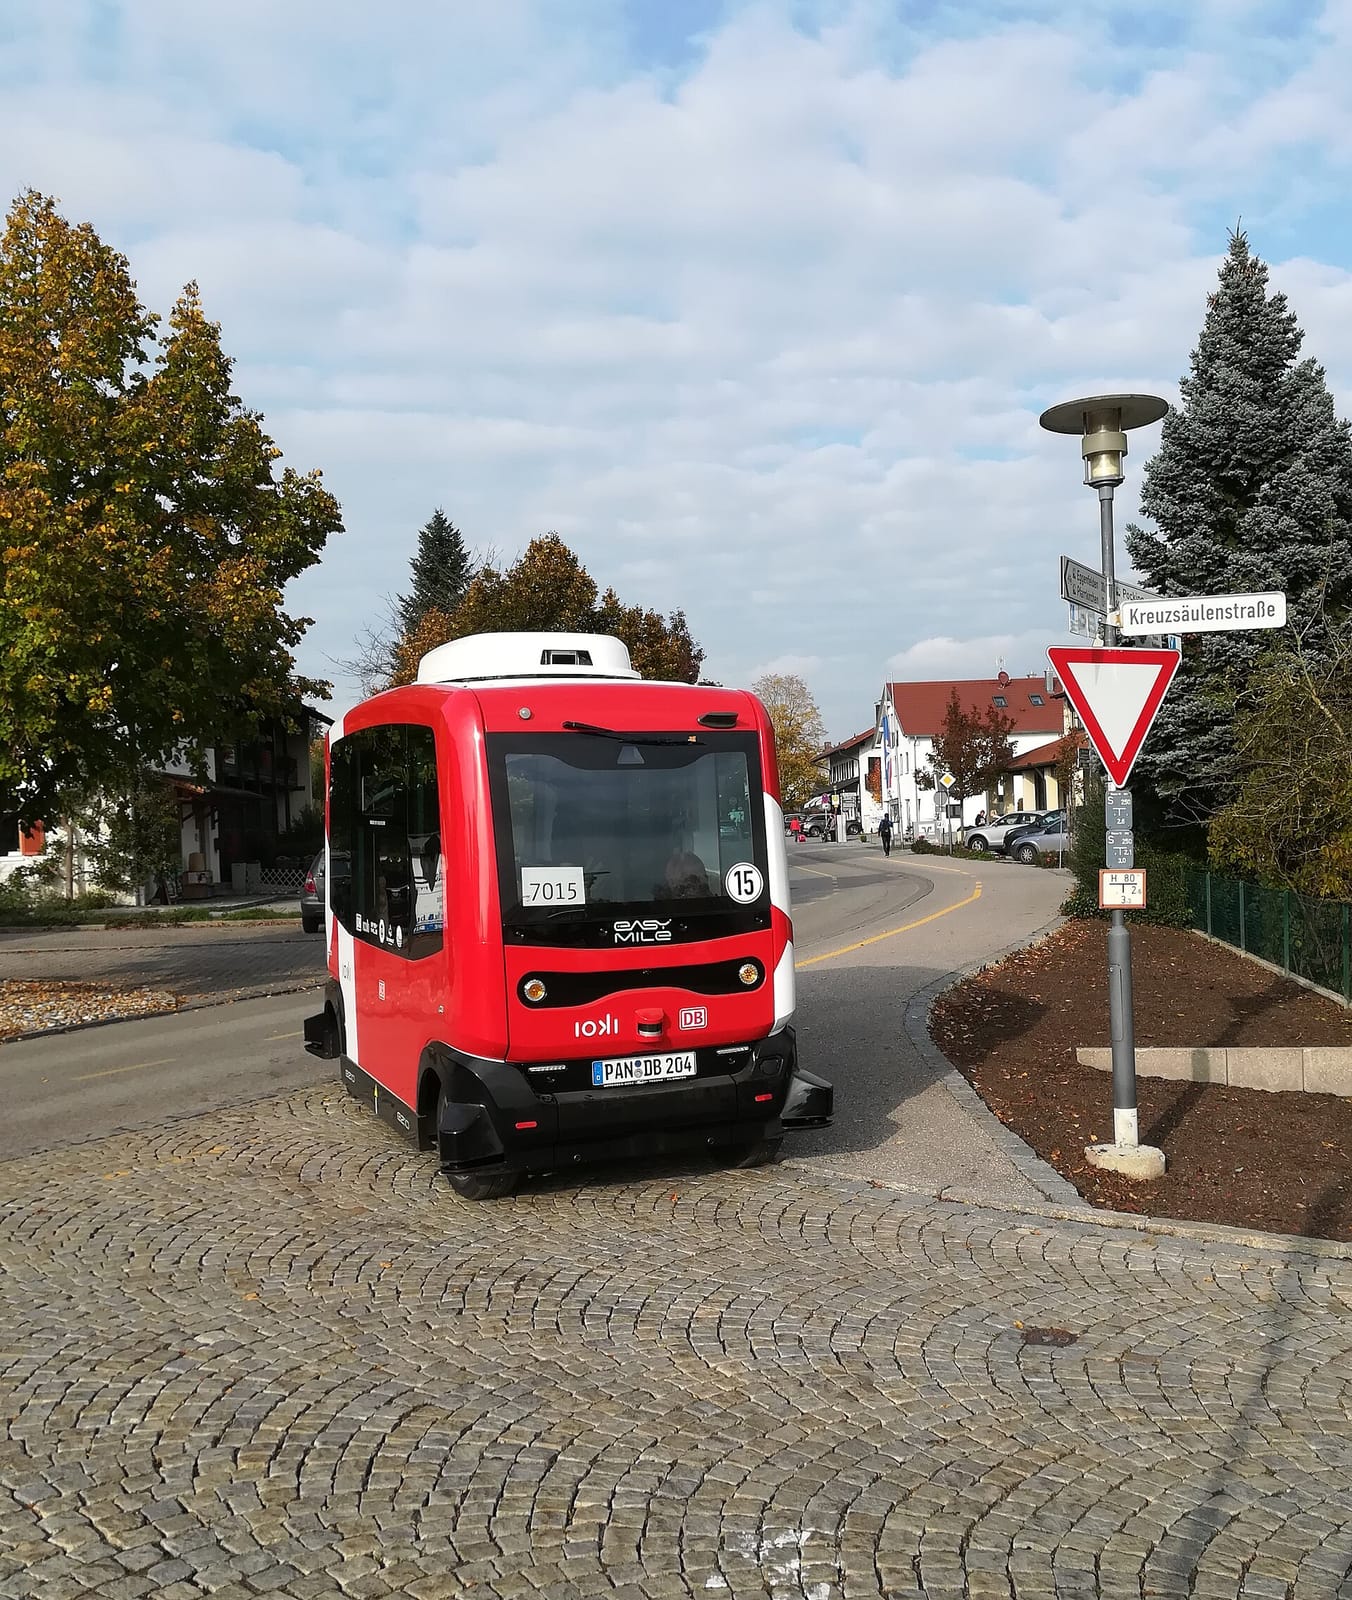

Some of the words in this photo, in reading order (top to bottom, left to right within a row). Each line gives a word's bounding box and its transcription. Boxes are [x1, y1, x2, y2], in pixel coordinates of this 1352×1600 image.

[1129, 600, 1276, 626] Kreuzsäulenstraße
[1107, 796, 1114, 805] S
[1107, 835, 1115, 845] S
[733, 870, 755, 896] 15
[1111, 874, 1118, 883] H
[1124, 873, 1136, 883] 80
[529, 882, 578, 902] 7015
[614, 931, 672, 944] MILE
[683, 1011, 704, 1026] DB
[604, 1060, 634, 1081] PAN
[643, 1059, 662, 1077] DB
[666, 1055, 692, 1074] 204
